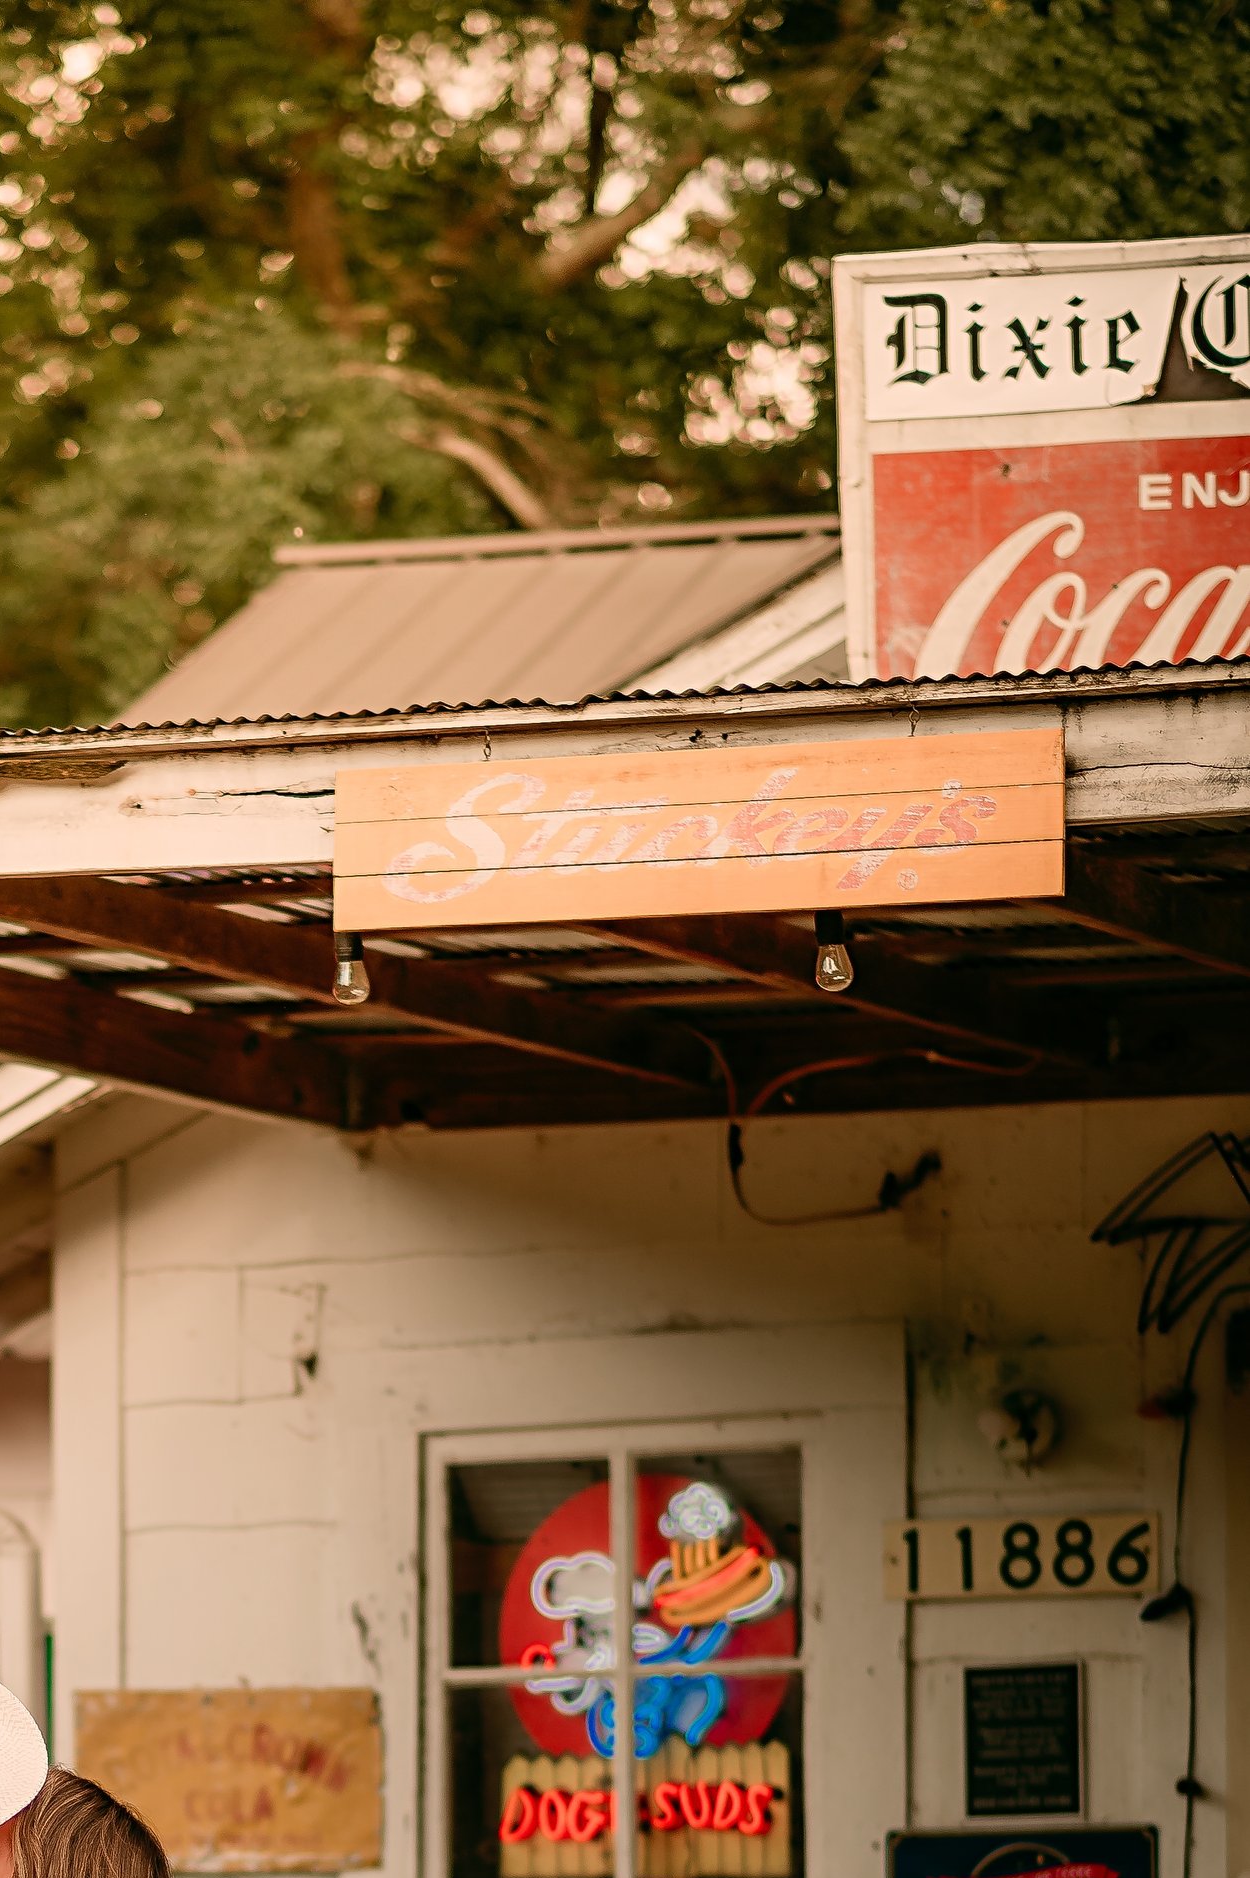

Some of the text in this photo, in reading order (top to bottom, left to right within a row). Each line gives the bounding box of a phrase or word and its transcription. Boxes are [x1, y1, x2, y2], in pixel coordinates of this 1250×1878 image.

[882, 293, 1141, 386] Dixie
[382, 766, 999, 904] Stuckey's
[903, 1519, 1149, 1592] 11886
[653, 1781, 773, 1836] SUDS
